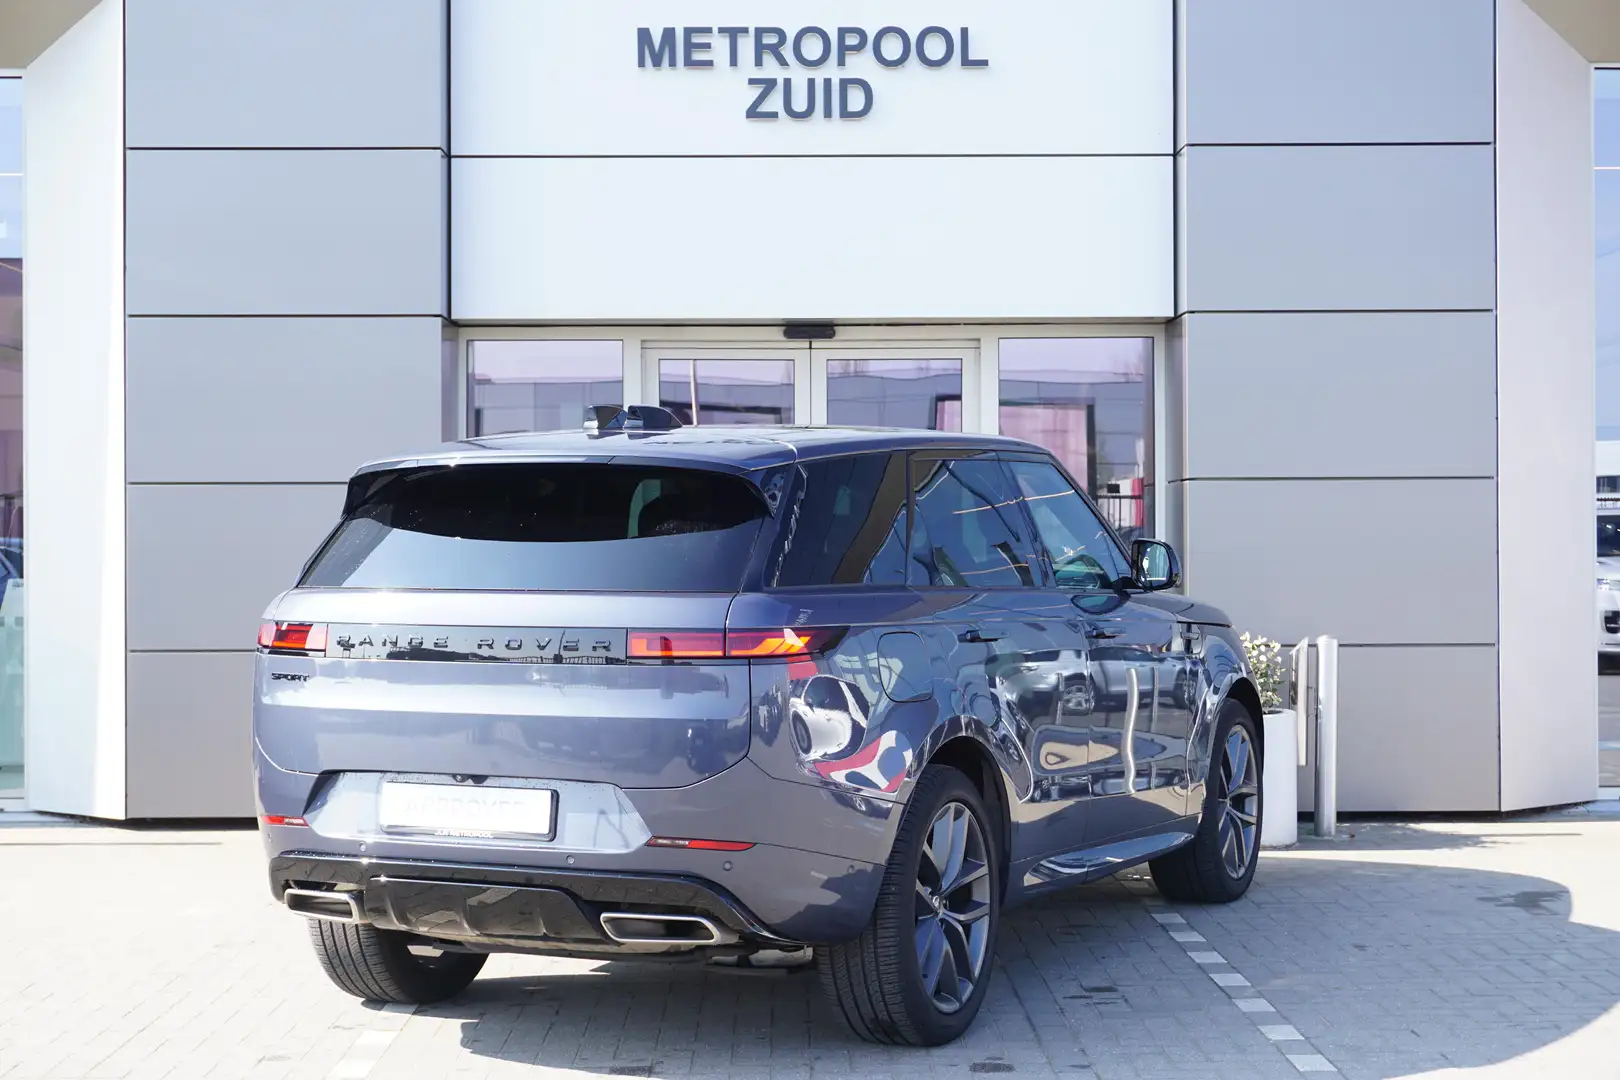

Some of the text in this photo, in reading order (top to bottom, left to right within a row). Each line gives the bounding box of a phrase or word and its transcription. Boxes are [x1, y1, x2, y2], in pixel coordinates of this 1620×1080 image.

[636, 26, 989, 68] METROPOOL
[745, 77, 874, 119] ZUID
[336, 633, 611, 652] RANGE ROVER
[271, 672, 310, 682] SPORT
